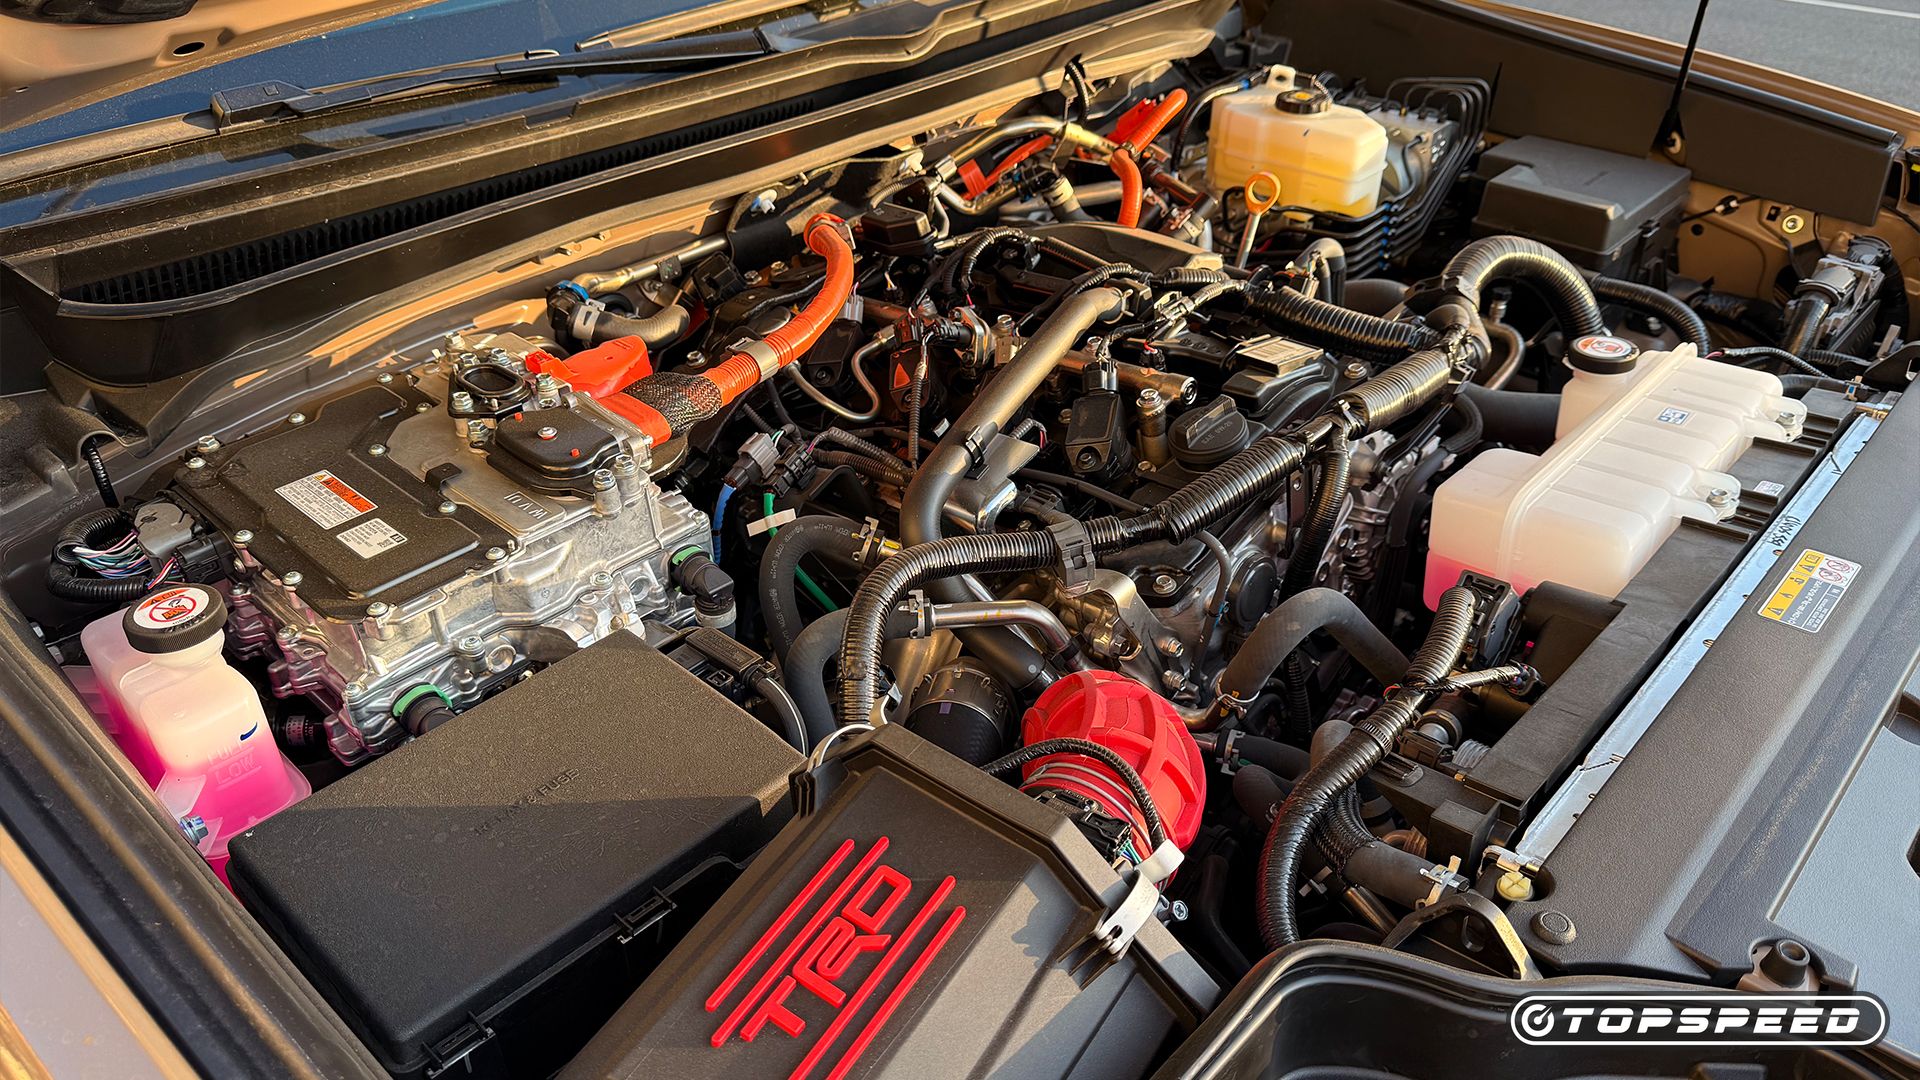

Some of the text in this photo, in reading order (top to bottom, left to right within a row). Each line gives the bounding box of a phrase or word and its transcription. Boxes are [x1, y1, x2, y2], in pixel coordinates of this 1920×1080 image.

[214, 752, 257, 785] LOW
[473, 800, 524, 836] RLAY
[539, 768, 580, 797] FUSE
[740, 865, 912, 1042] TRD
